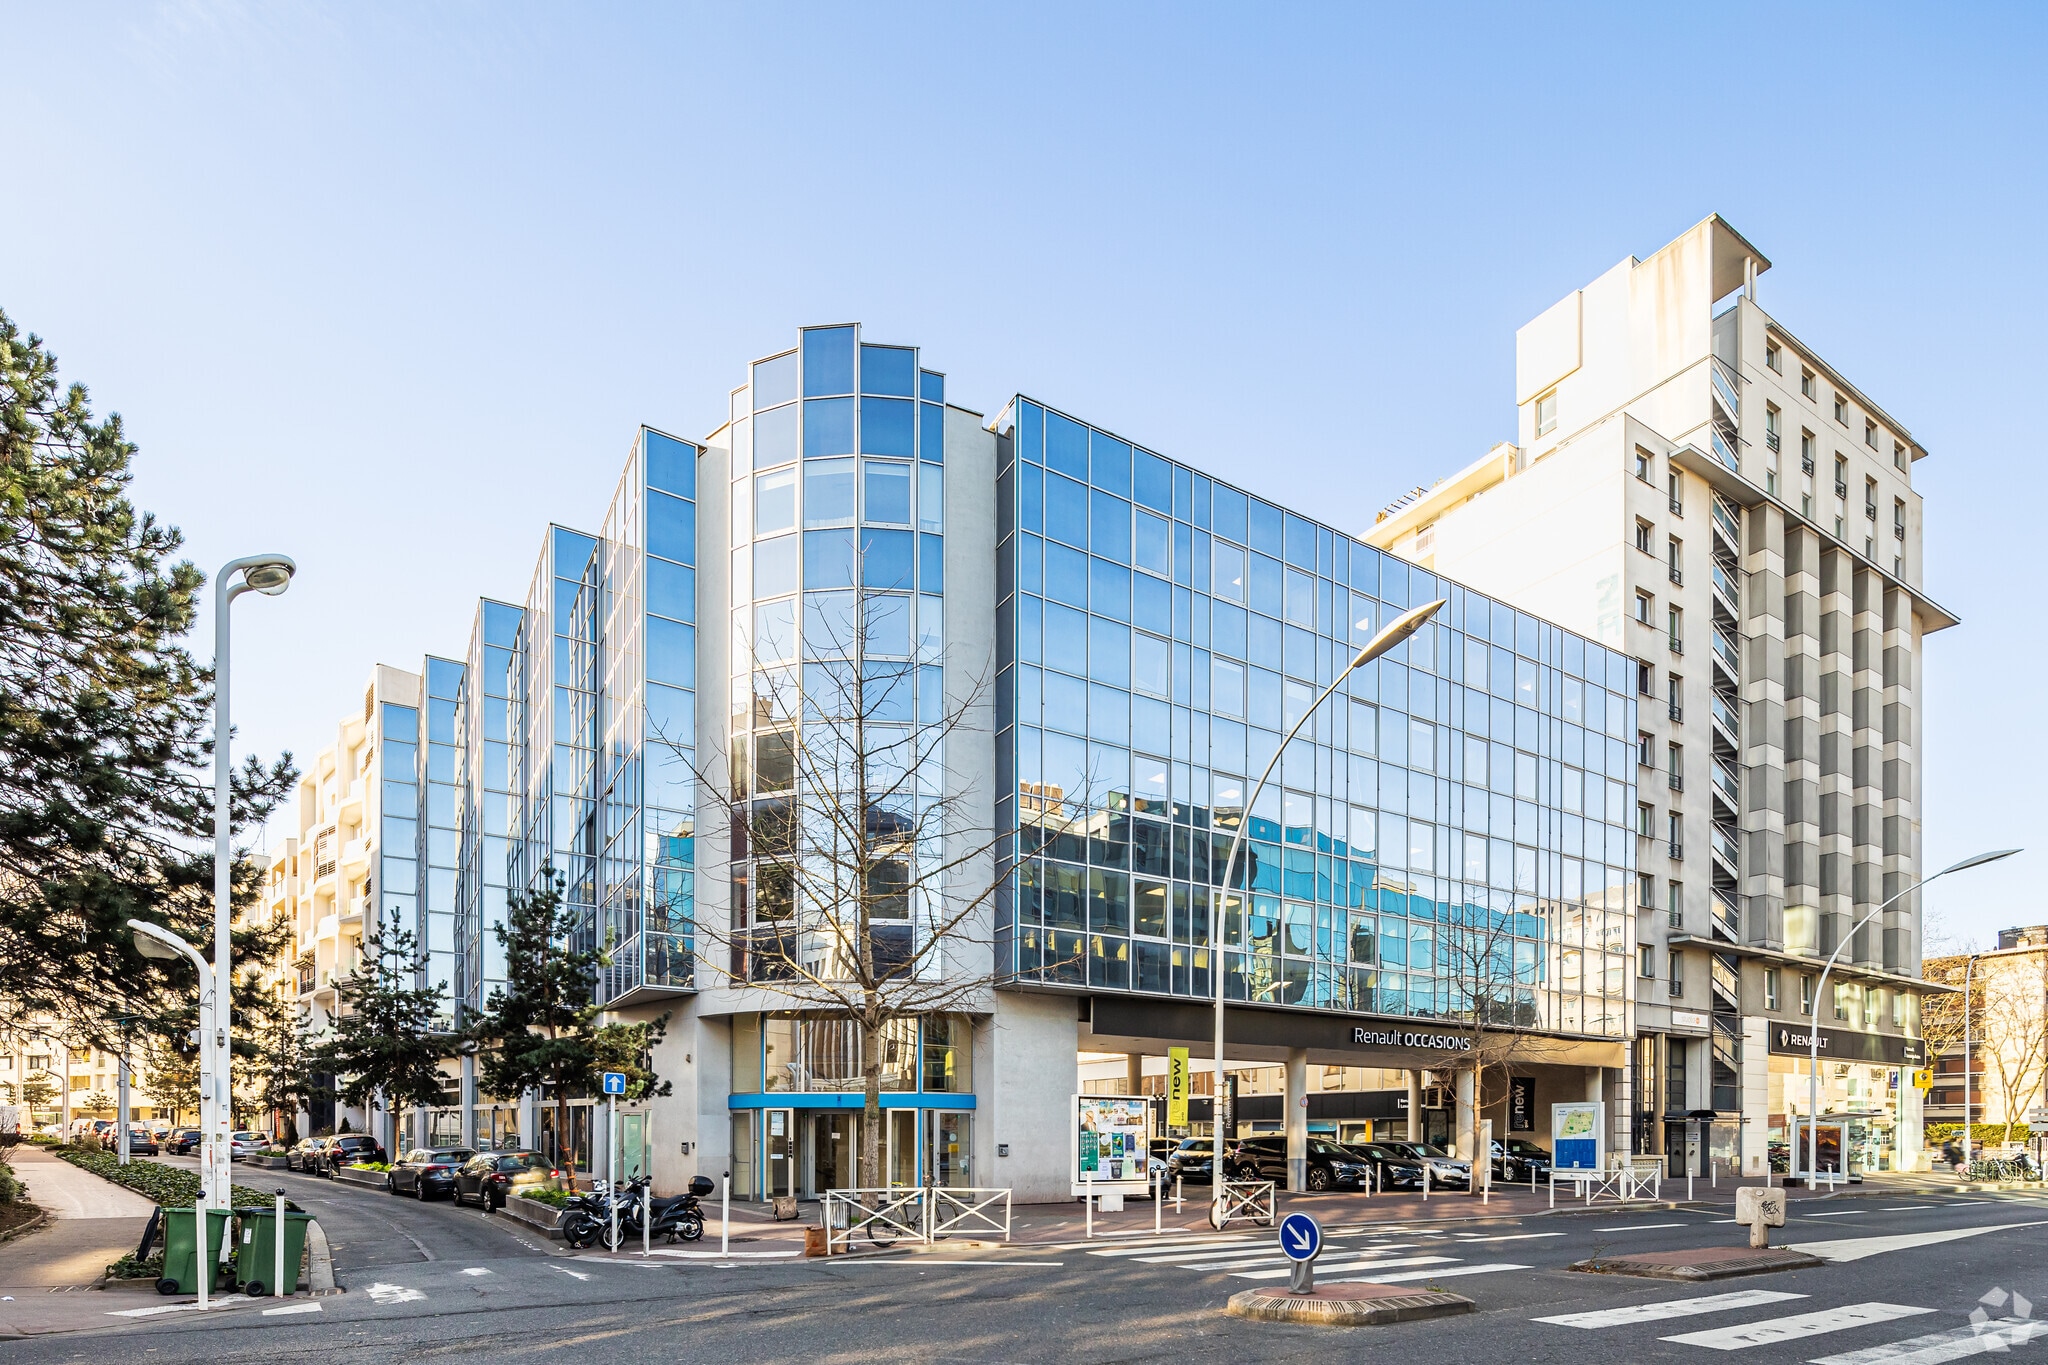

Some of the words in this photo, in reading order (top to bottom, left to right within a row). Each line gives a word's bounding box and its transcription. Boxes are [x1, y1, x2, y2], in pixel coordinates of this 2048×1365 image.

[1354, 1027, 1402, 1046] Renault
[1404, 1032, 1471, 1051] OCCASIONS
[1514, 1084, 1525, 1129] renew
